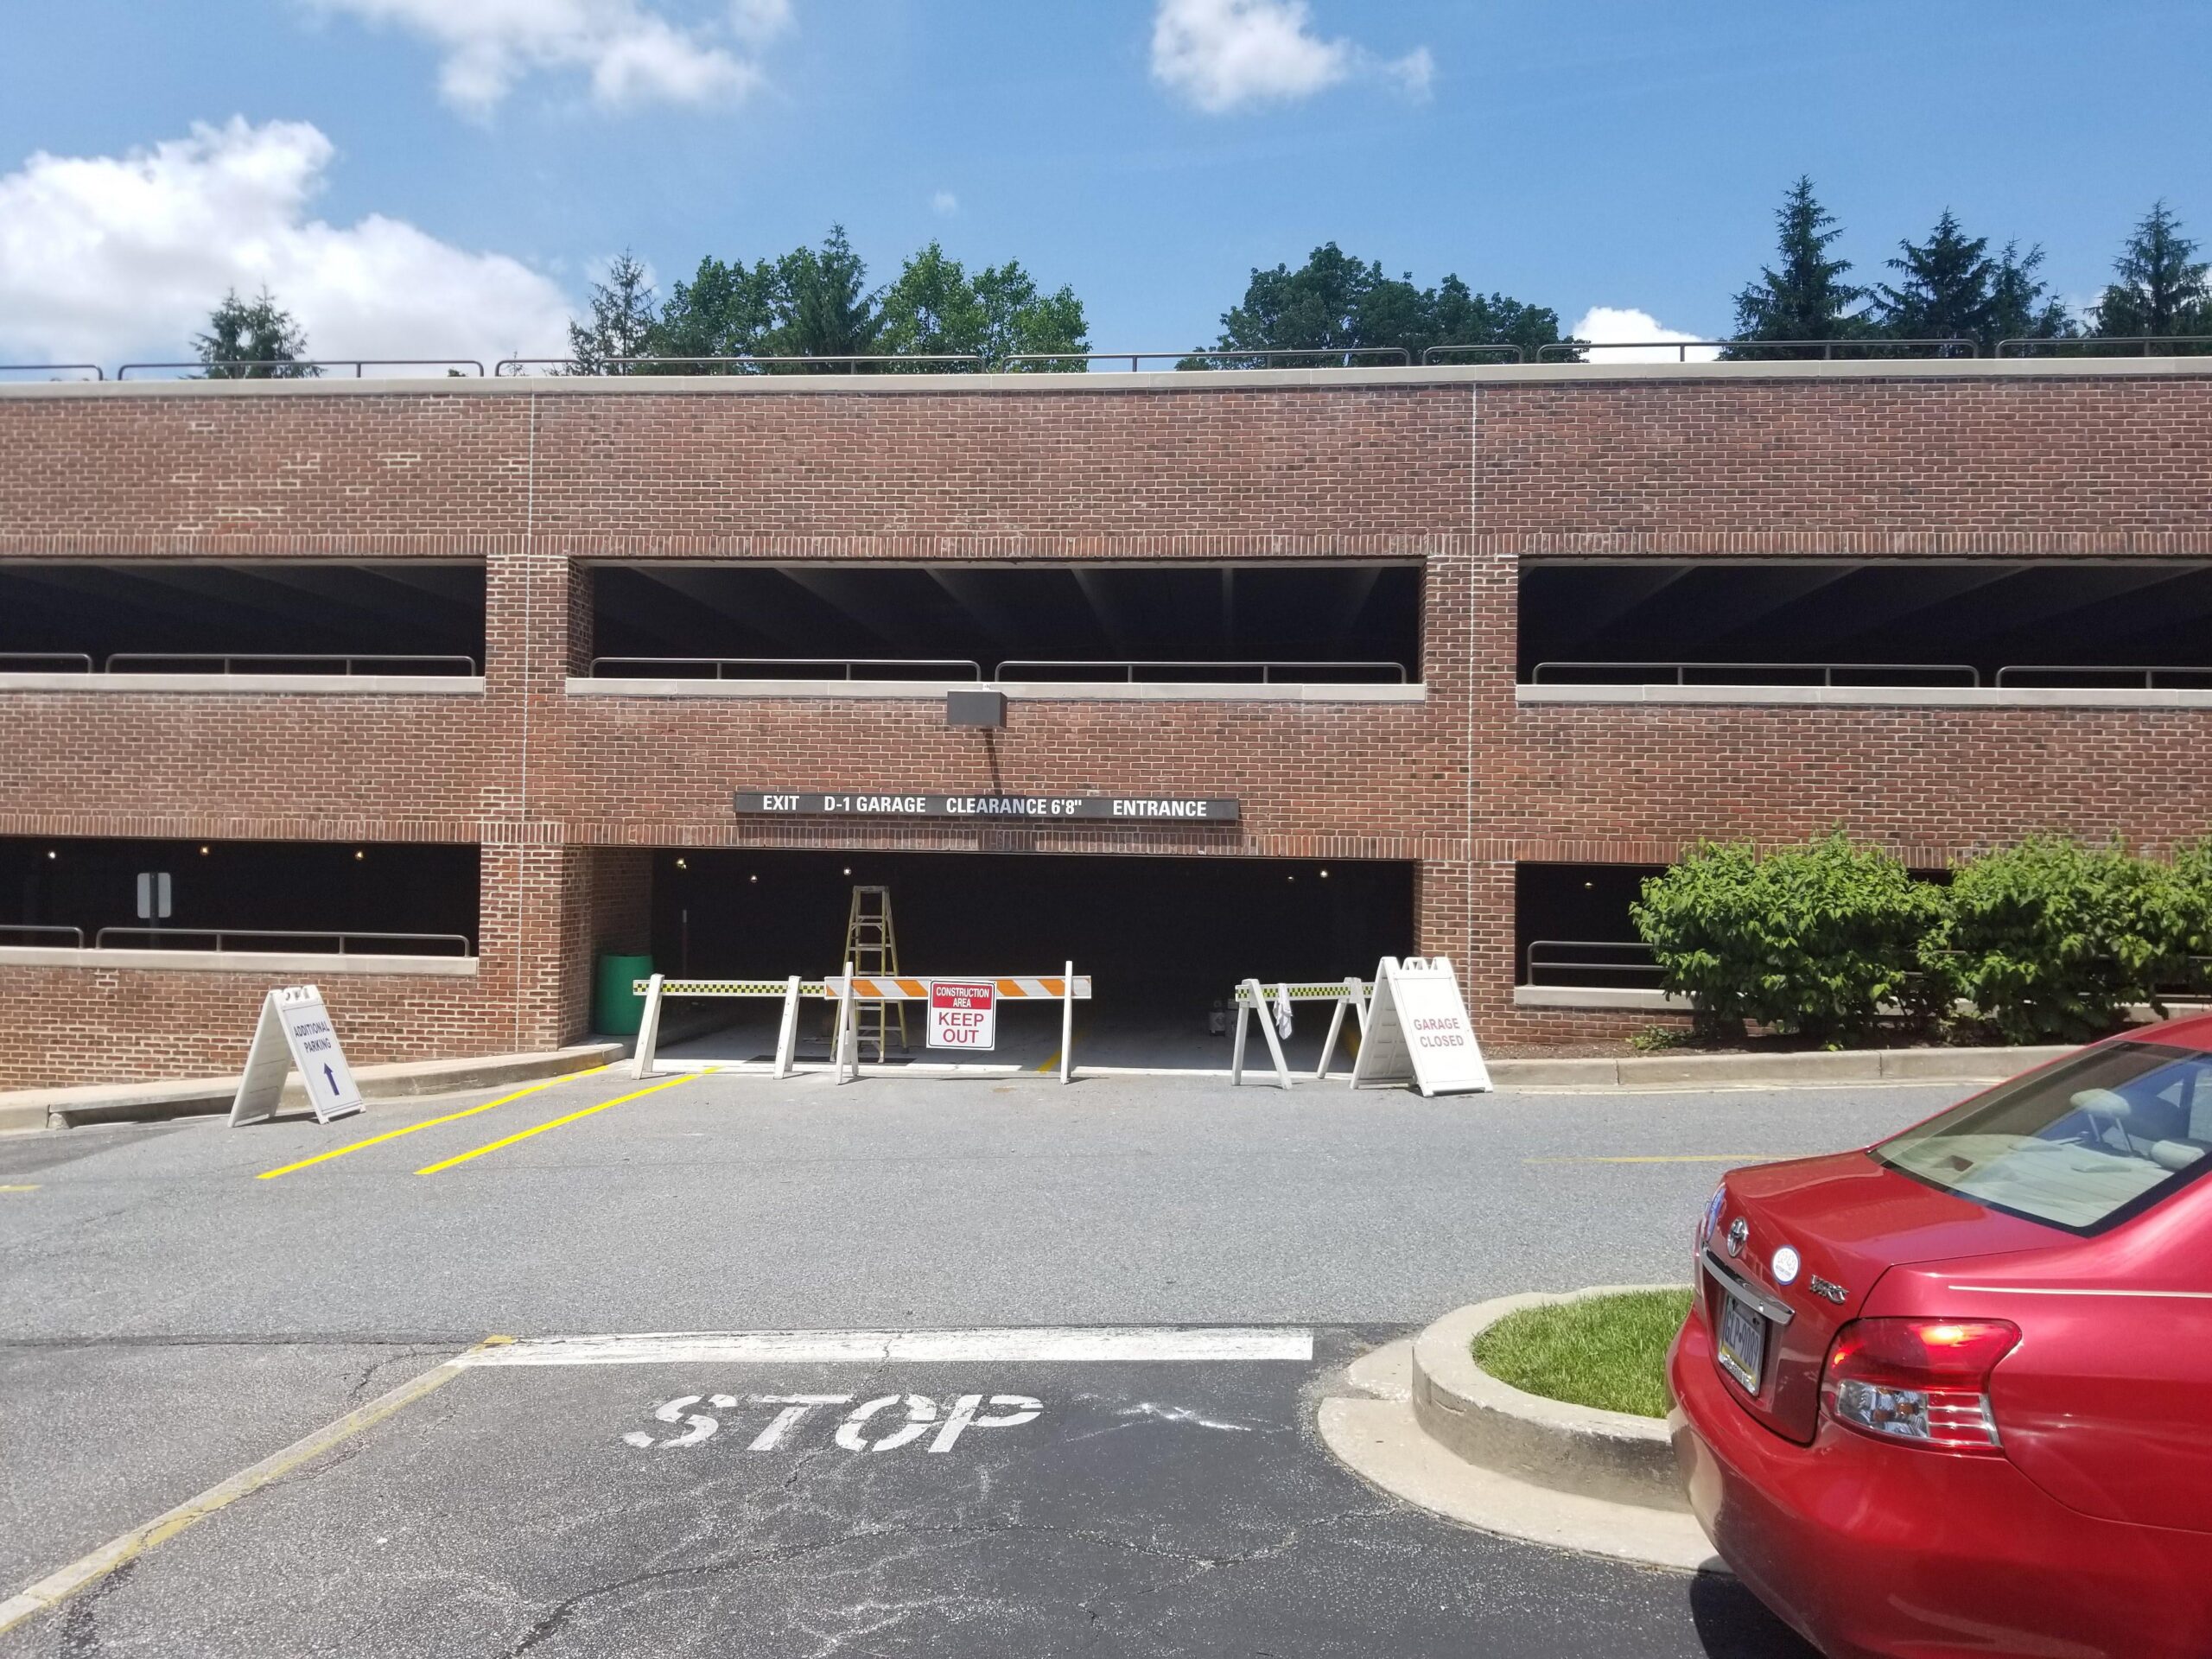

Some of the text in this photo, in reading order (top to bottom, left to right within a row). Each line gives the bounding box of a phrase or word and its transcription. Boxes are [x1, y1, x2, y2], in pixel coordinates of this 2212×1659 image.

[762, 795, 1207, 817] EXIT D-1 GARAGE CLEARANCE 6'8" ENTRANCE
[936, 987, 989, 998] CONSTRUCTION
[952, 998, 972, 1007] AREA
[938, 1012, 984, 1027] KEEP
[1414, 1018, 1460, 1031] GARAGE
[293, 1020, 330, 1038] ADDITIONAL
[943, 1028, 979, 1044] OUT
[303, 1038, 332, 1053] PARKING
[1420, 1035, 1465, 1047] CLOSED
[621, 1394, 1044, 1453] STOP
